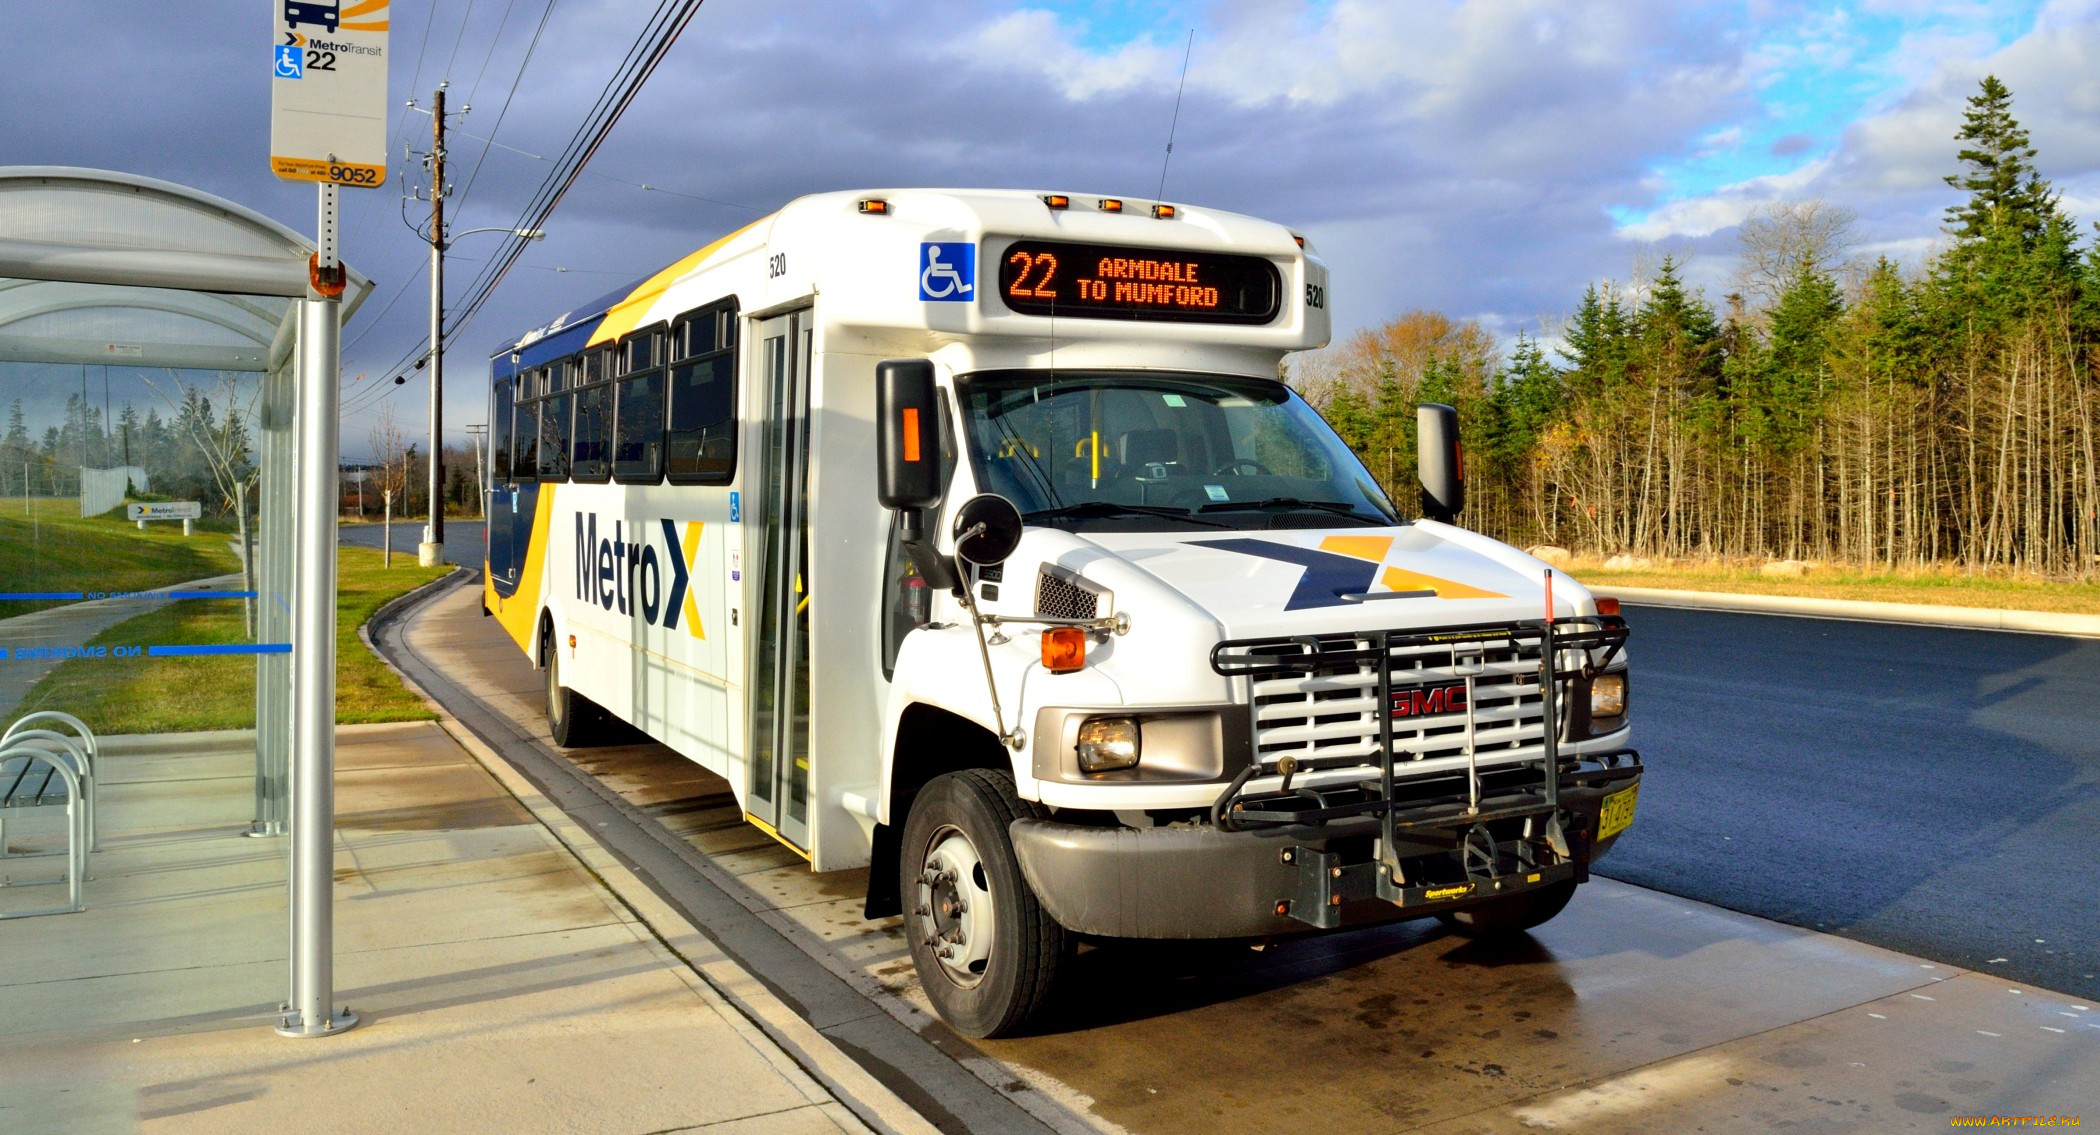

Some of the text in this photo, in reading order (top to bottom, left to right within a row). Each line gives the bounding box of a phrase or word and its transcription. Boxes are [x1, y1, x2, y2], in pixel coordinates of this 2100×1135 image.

[309, 38, 382, 56] MetroTransit
[306, 50, 336, 71] 22
[329, 165, 377, 184] 9052
[769, 252, 786, 279] 520
[1010, 251, 1057, 298] 22
[1098, 257, 1199, 283] ARMDALE
[1077, 279, 1219, 307] TO MUMFORD
[1306, 283, 1323, 310] 520
[87, 591, 106, 600] NO
[1391, 685, 1468, 717] GMC
